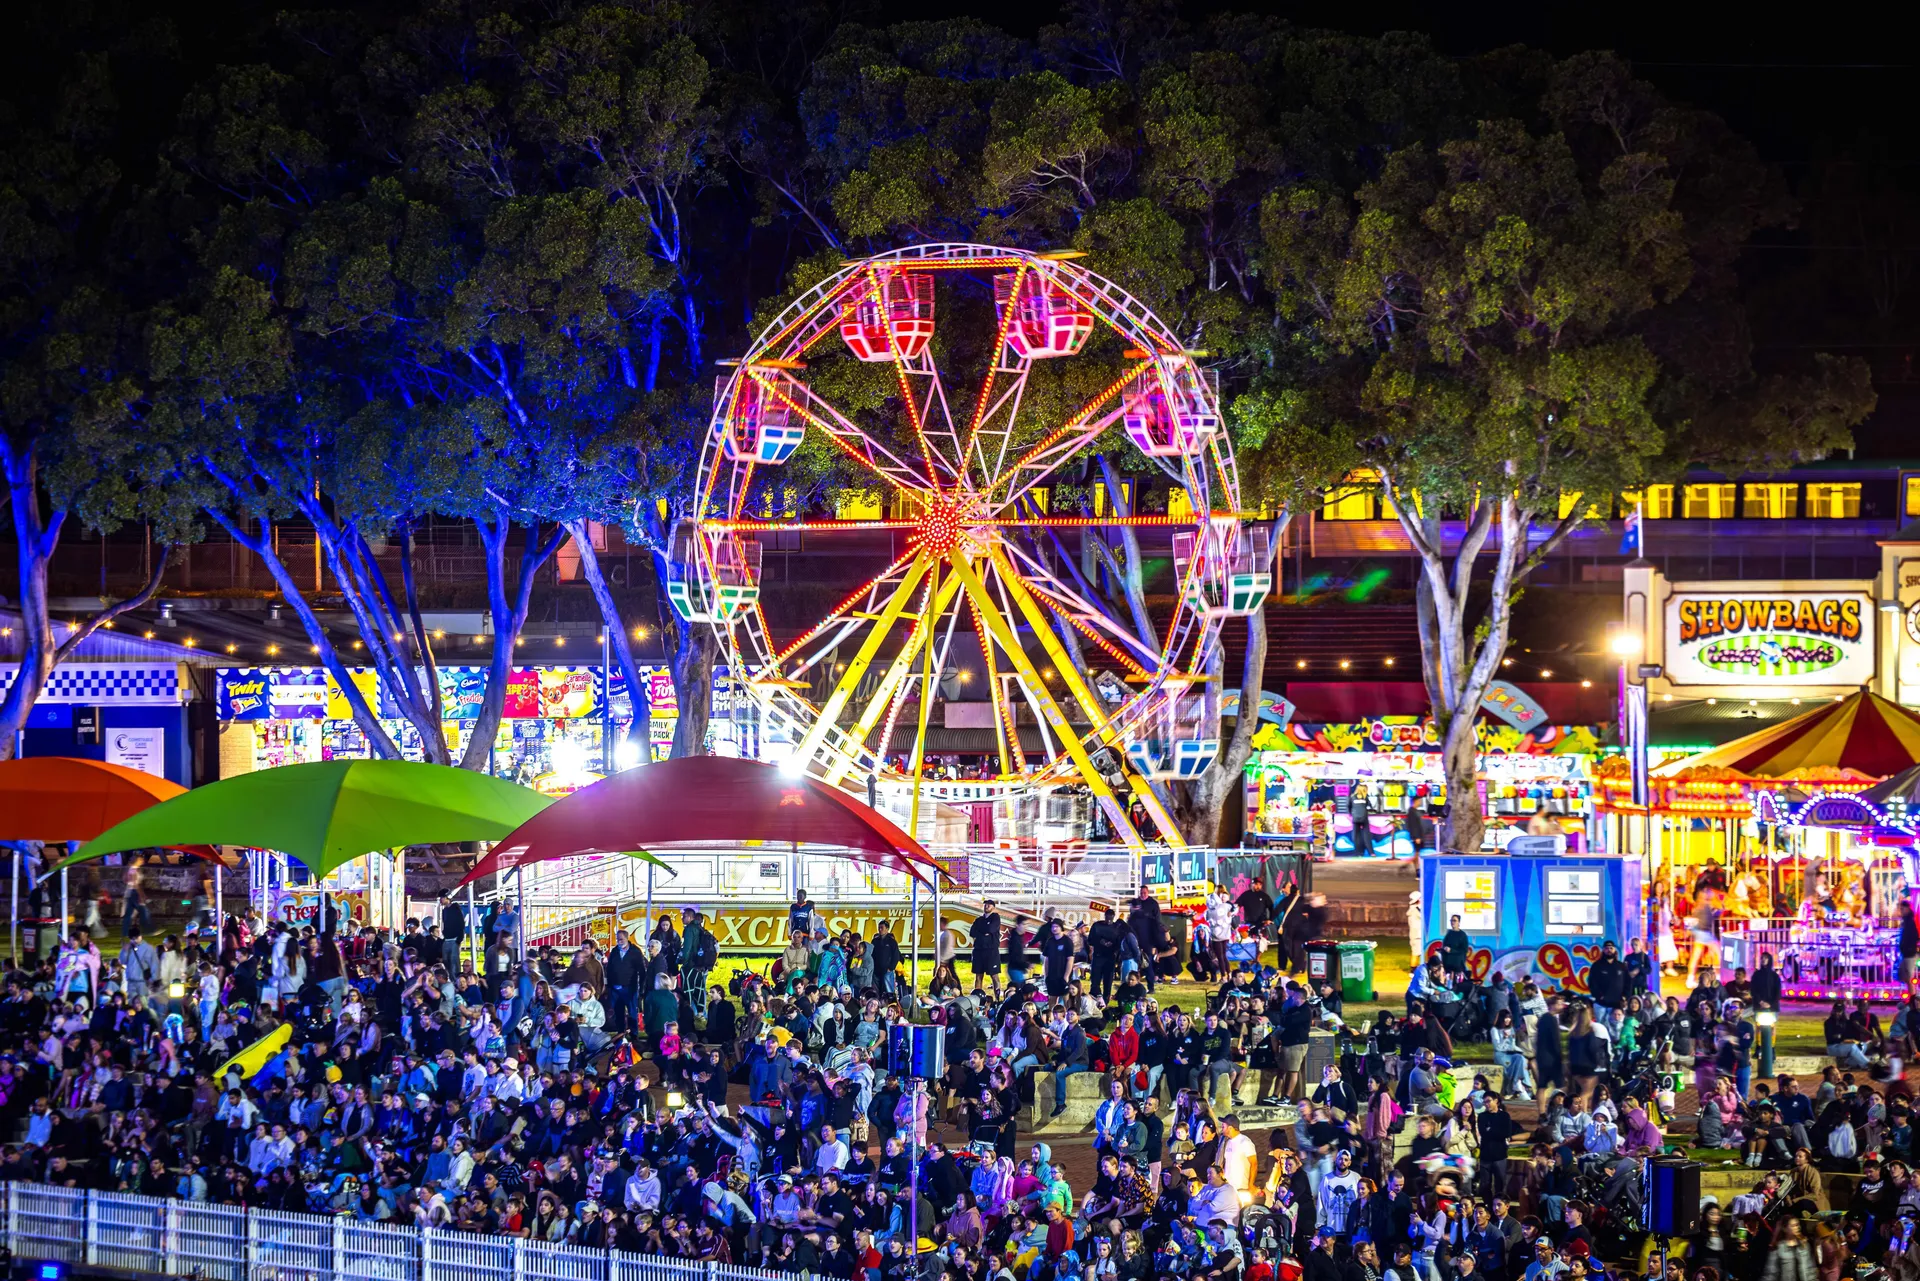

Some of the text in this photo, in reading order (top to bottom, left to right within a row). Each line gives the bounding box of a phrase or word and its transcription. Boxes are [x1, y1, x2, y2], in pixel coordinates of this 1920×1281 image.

[1680, 599, 1861, 643] SHOWBAGS
[565, 673, 592, 684] Caramello
[228, 680, 265, 697] Twirl
[570, 683, 588, 692] Koala
[458, 693, 484, 706] Freddo
[1372, 724, 1421, 744] SUPER
[1092, 902, 1107, 910] EXIT
[283, 904, 342, 923] TICKS
[888, 909, 924, 917] WHEL
